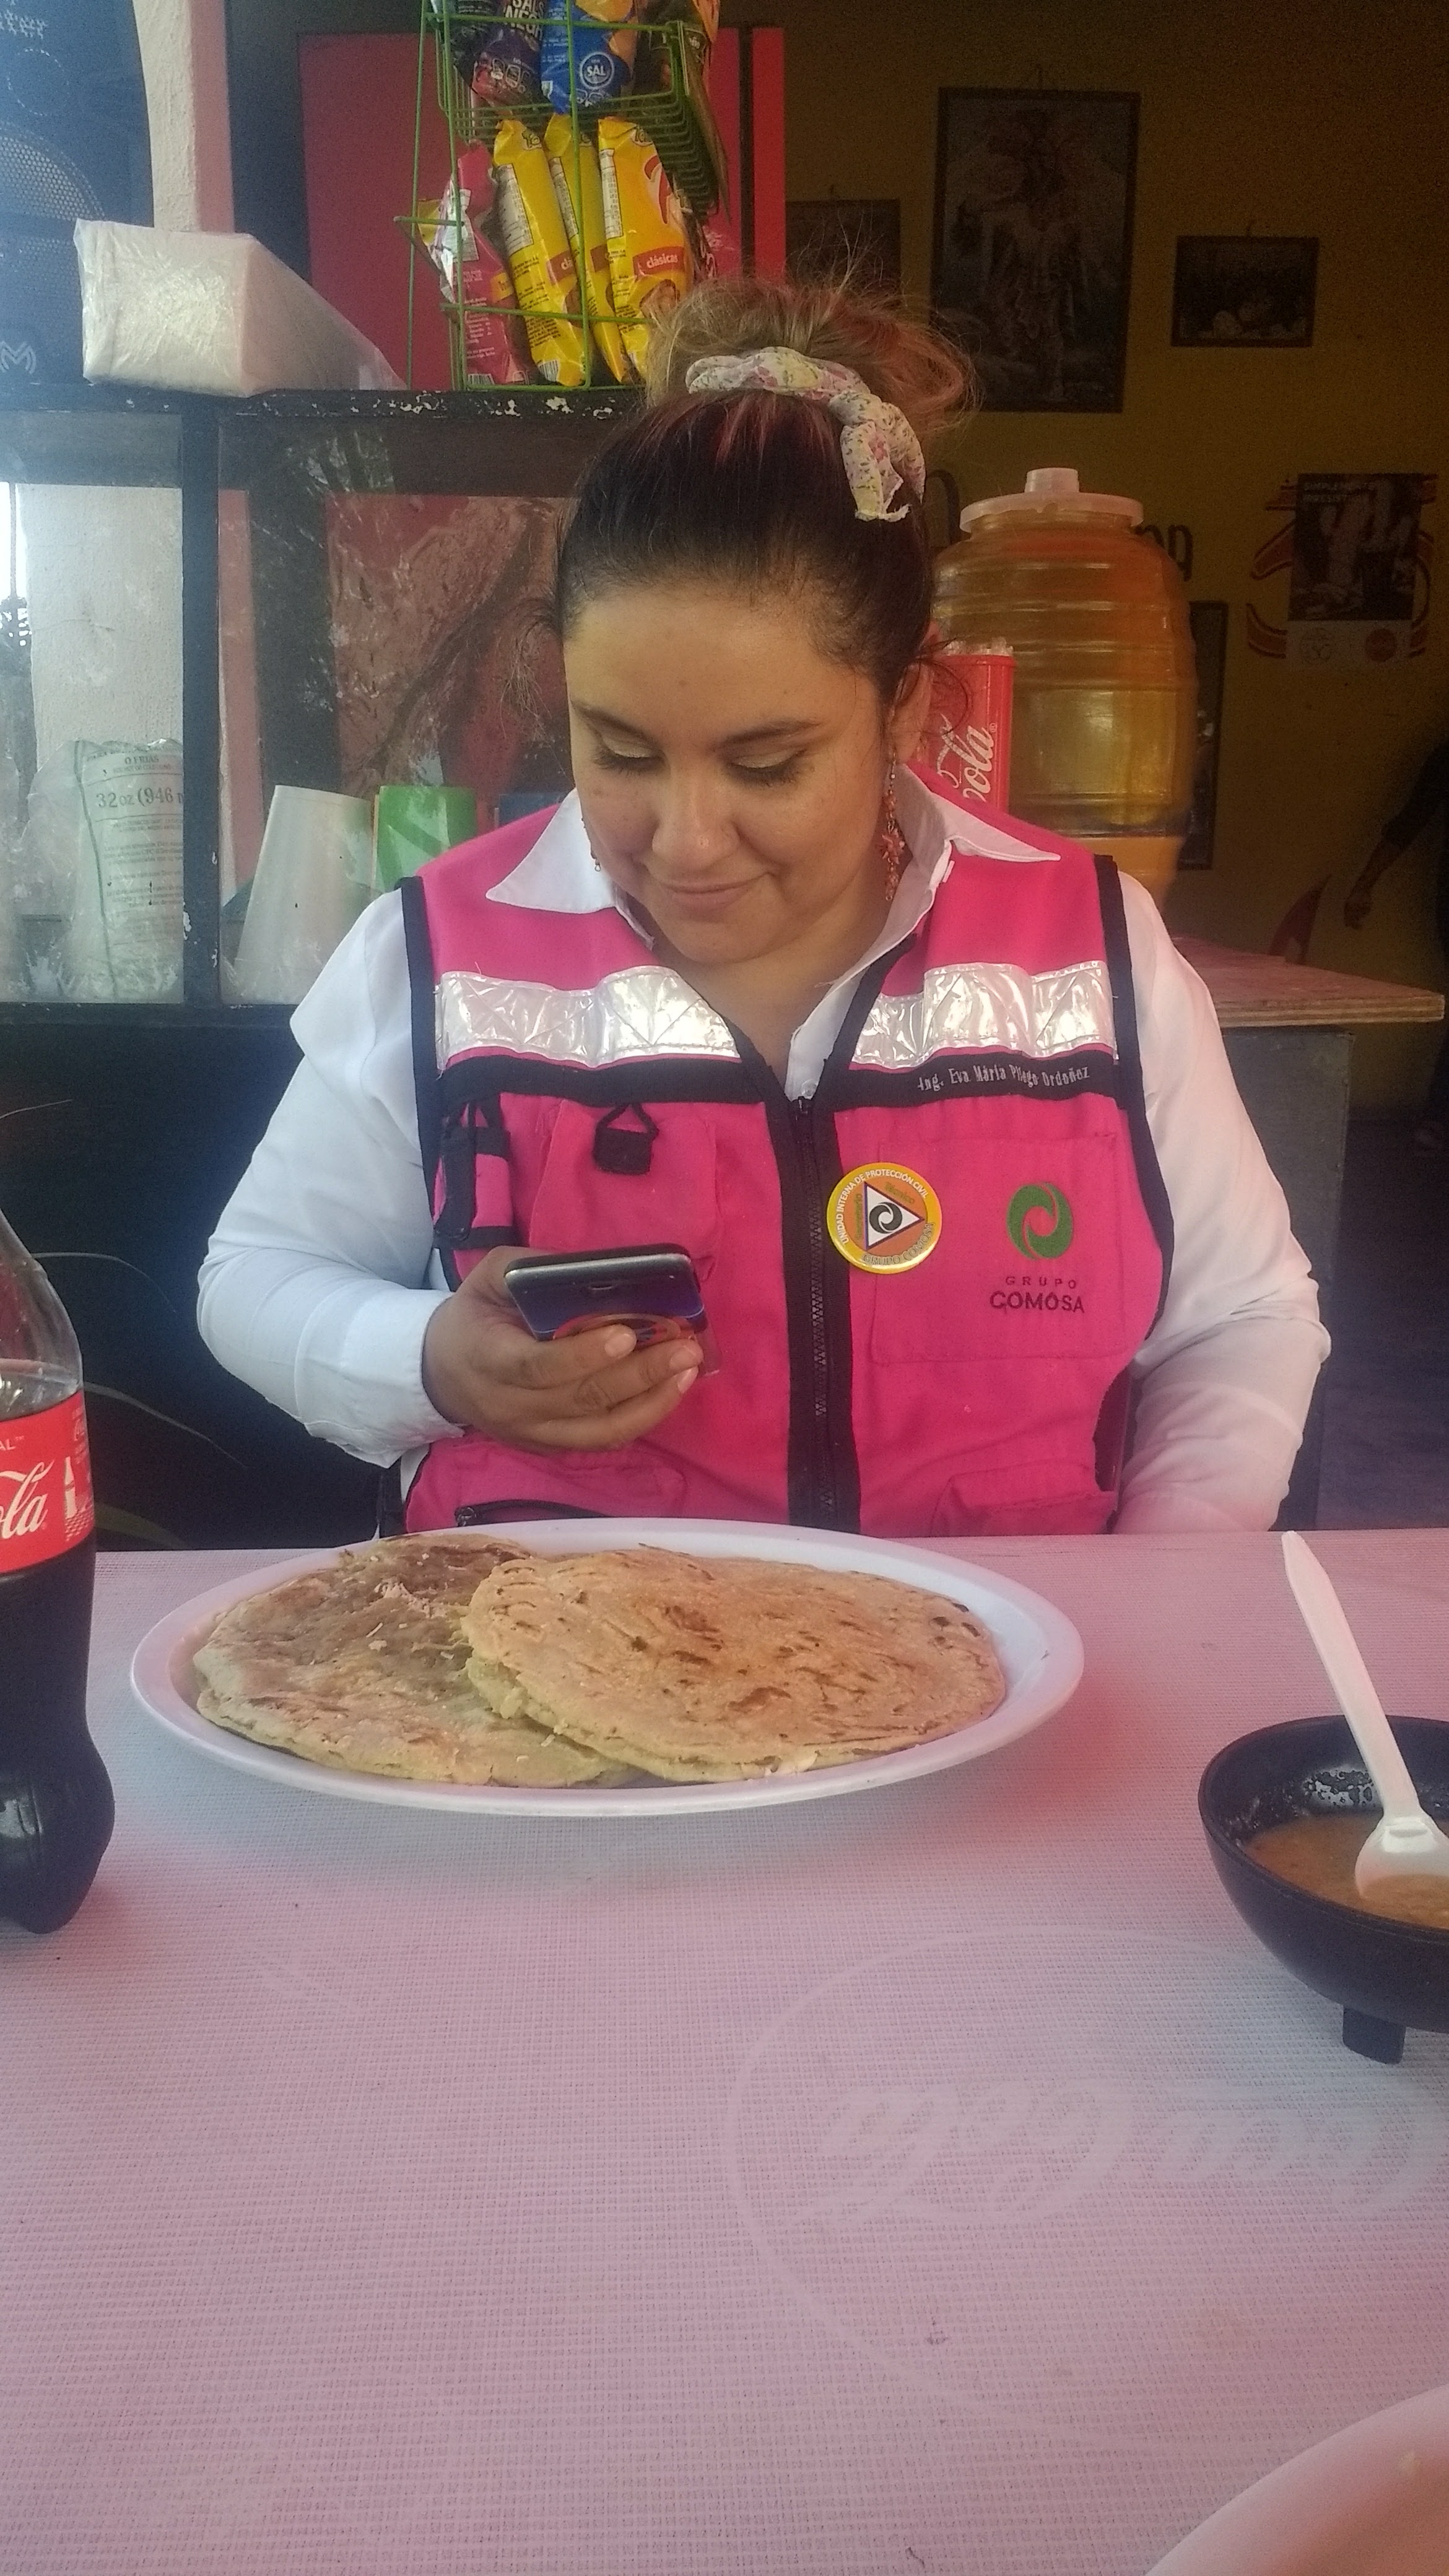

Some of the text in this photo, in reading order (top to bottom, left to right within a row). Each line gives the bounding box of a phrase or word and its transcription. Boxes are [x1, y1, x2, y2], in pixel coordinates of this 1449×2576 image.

[586, 64, 606, 77] SAL
[646, 253, 679, 269] clásicas
[97, 793, 118, 807] 32
[137, 787, 173, 807] (946
[948, 1068, 970, 1084] Eva
[836, 1169, 928, 1244] UNIDAD INTERNA DE PROTECCIÓN CIVIL
[863, 1222, 935, 1265] GRUPO COMOSA
[1005, 1276, 1077, 1289] GRUPO
[990, 1290, 1085, 1313] COMOSA
